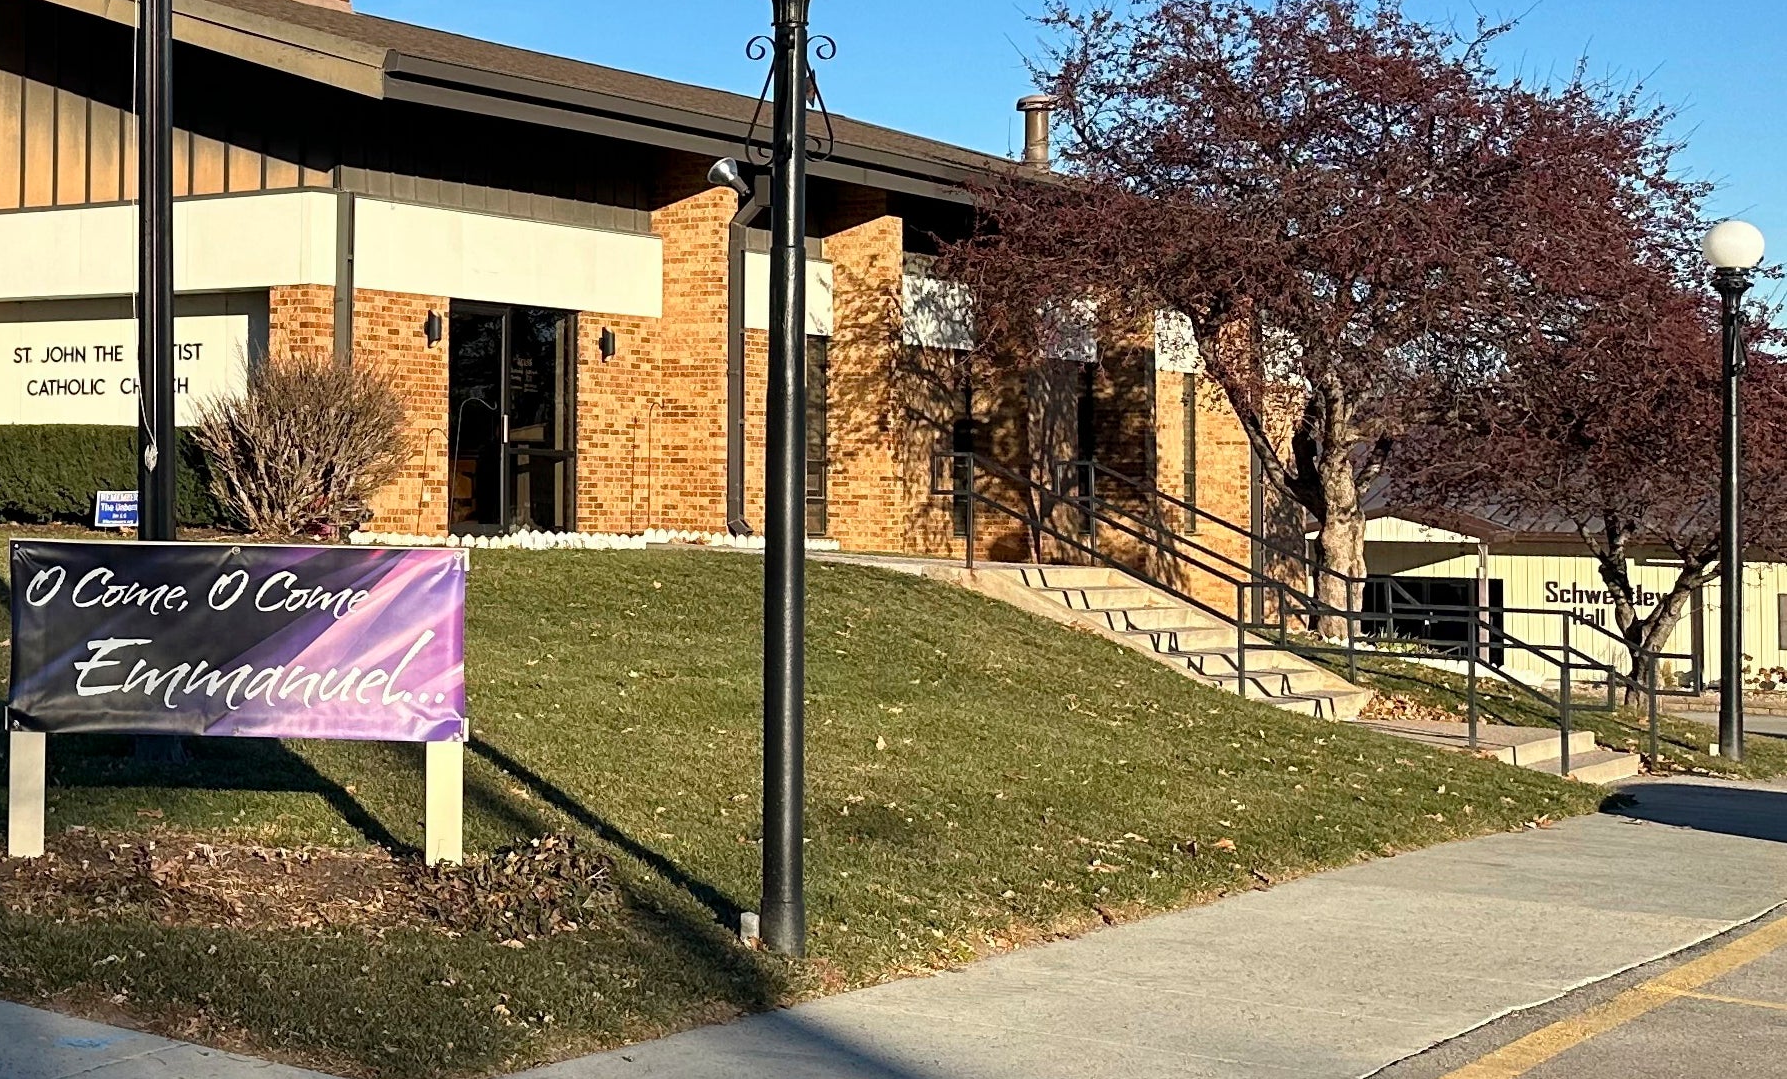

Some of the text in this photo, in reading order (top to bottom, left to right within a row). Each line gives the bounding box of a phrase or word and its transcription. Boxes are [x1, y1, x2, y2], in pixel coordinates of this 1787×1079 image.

[13, 345, 124, 364] ST. JOHN THE
[27, 378, 106, 396] CATHOLIC
[25, 565, 371, 620] O Come, O Come
[73, 629, 446, 710] Emmanuel...
